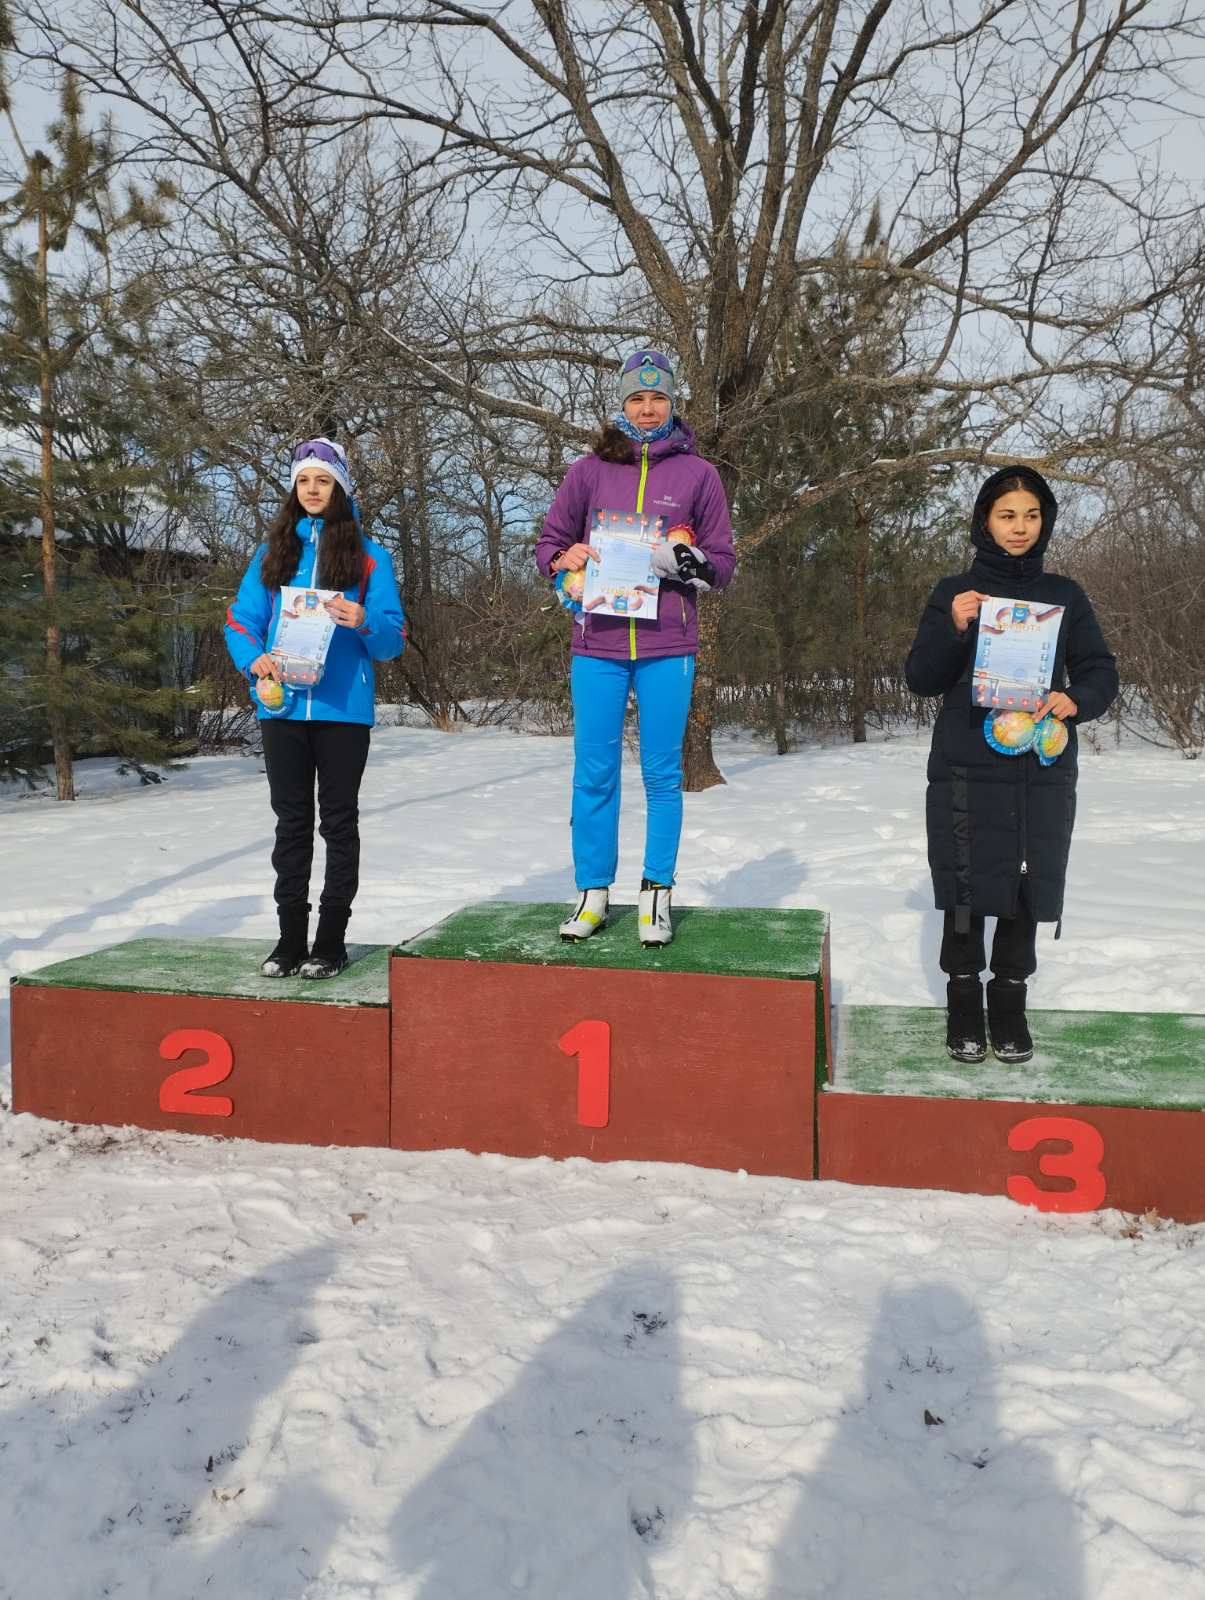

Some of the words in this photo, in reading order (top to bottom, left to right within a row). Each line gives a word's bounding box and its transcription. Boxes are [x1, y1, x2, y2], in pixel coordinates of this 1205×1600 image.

[158, 1029, 234, 1117] 2
[558, 1019, 611, 1128] 1
[1007, 1116, 1106, 1213] 3
